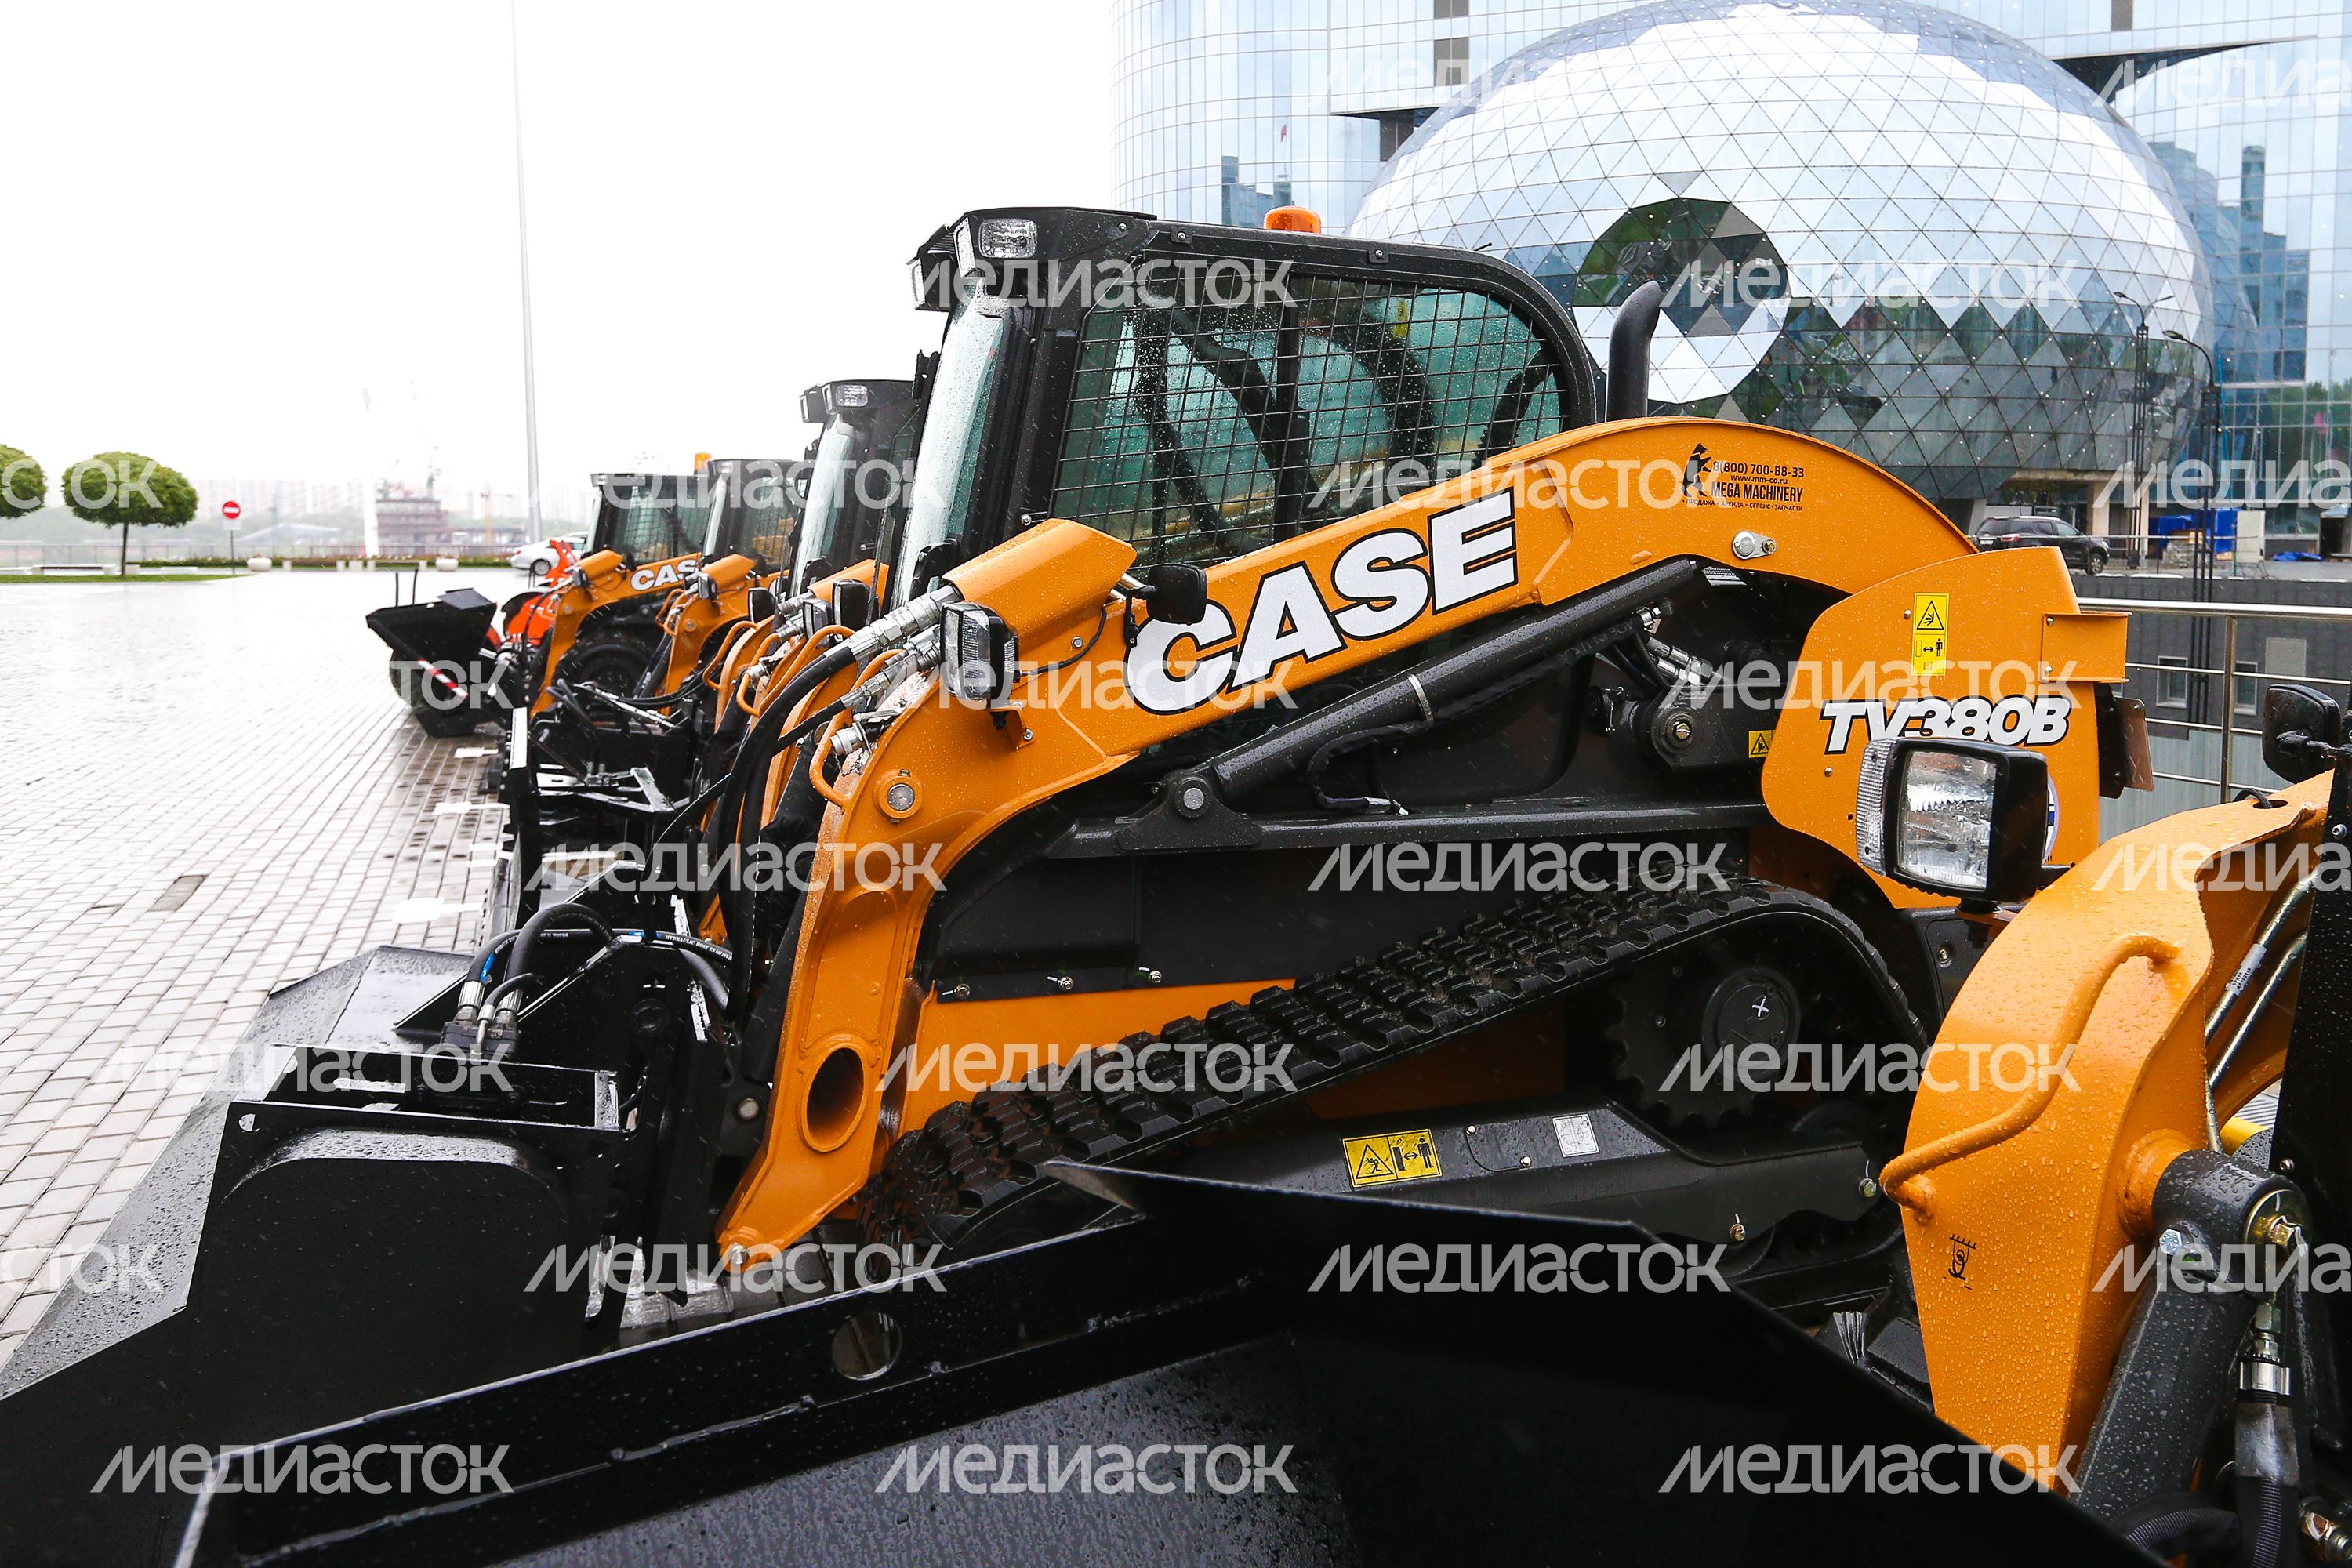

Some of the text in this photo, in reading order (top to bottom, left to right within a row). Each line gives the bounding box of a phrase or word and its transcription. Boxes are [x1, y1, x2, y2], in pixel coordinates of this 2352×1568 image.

[1731, 474, 1788, 485] www.mm-co.ru
[1751, 463, 1804, 478] 700-88-33
[1711, 481, 1803, 502] MEGA MACHINERY
[630, 559, 700, 592] CAS
[1123, 487, 1518, 715] CASE
[1820, 695, 2071, 754] TV380B
